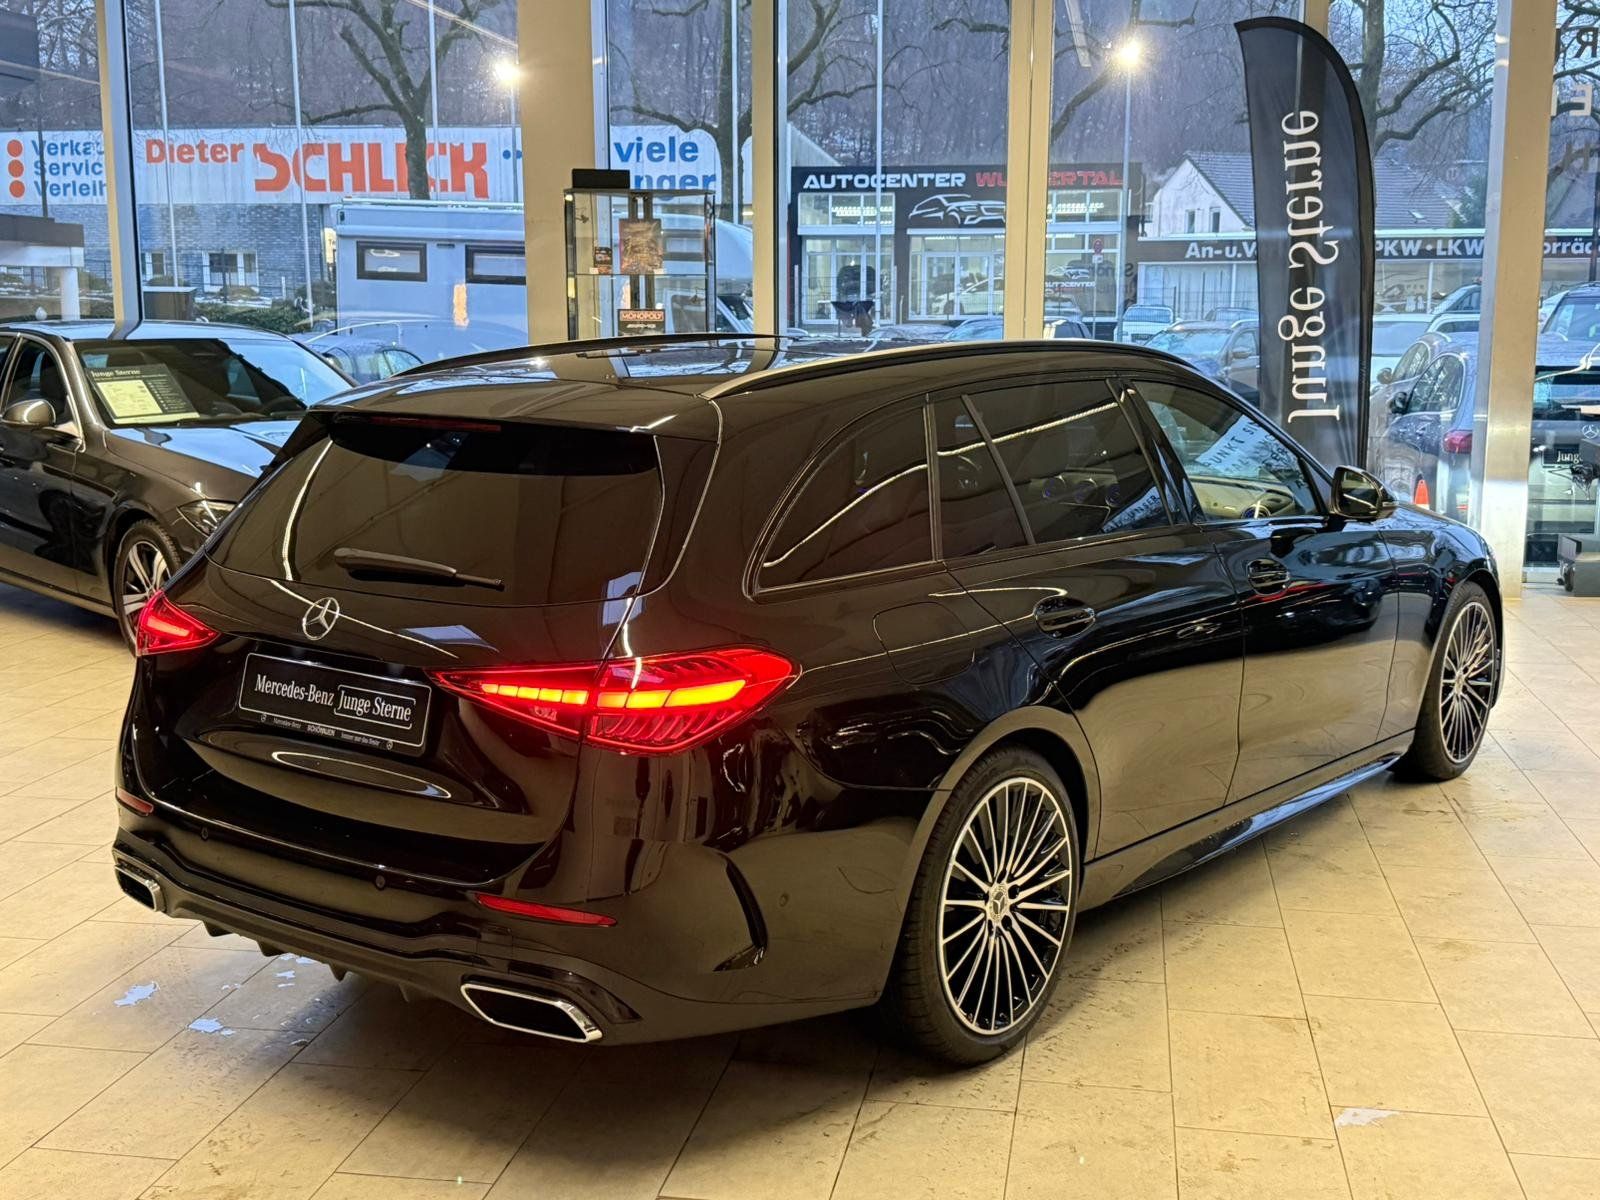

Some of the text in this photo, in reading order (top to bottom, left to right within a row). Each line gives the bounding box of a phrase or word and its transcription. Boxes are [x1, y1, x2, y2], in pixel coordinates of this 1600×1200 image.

[146, 139, 245, 164] Dieter
[613, 135, 699, 163] viele
[802, 172, 966, 189] AUTOCENTER
[1436, 239, 1483, 256] LKW
[254, 673, 412, 722] Mercedes-Benz Junge Sterne
